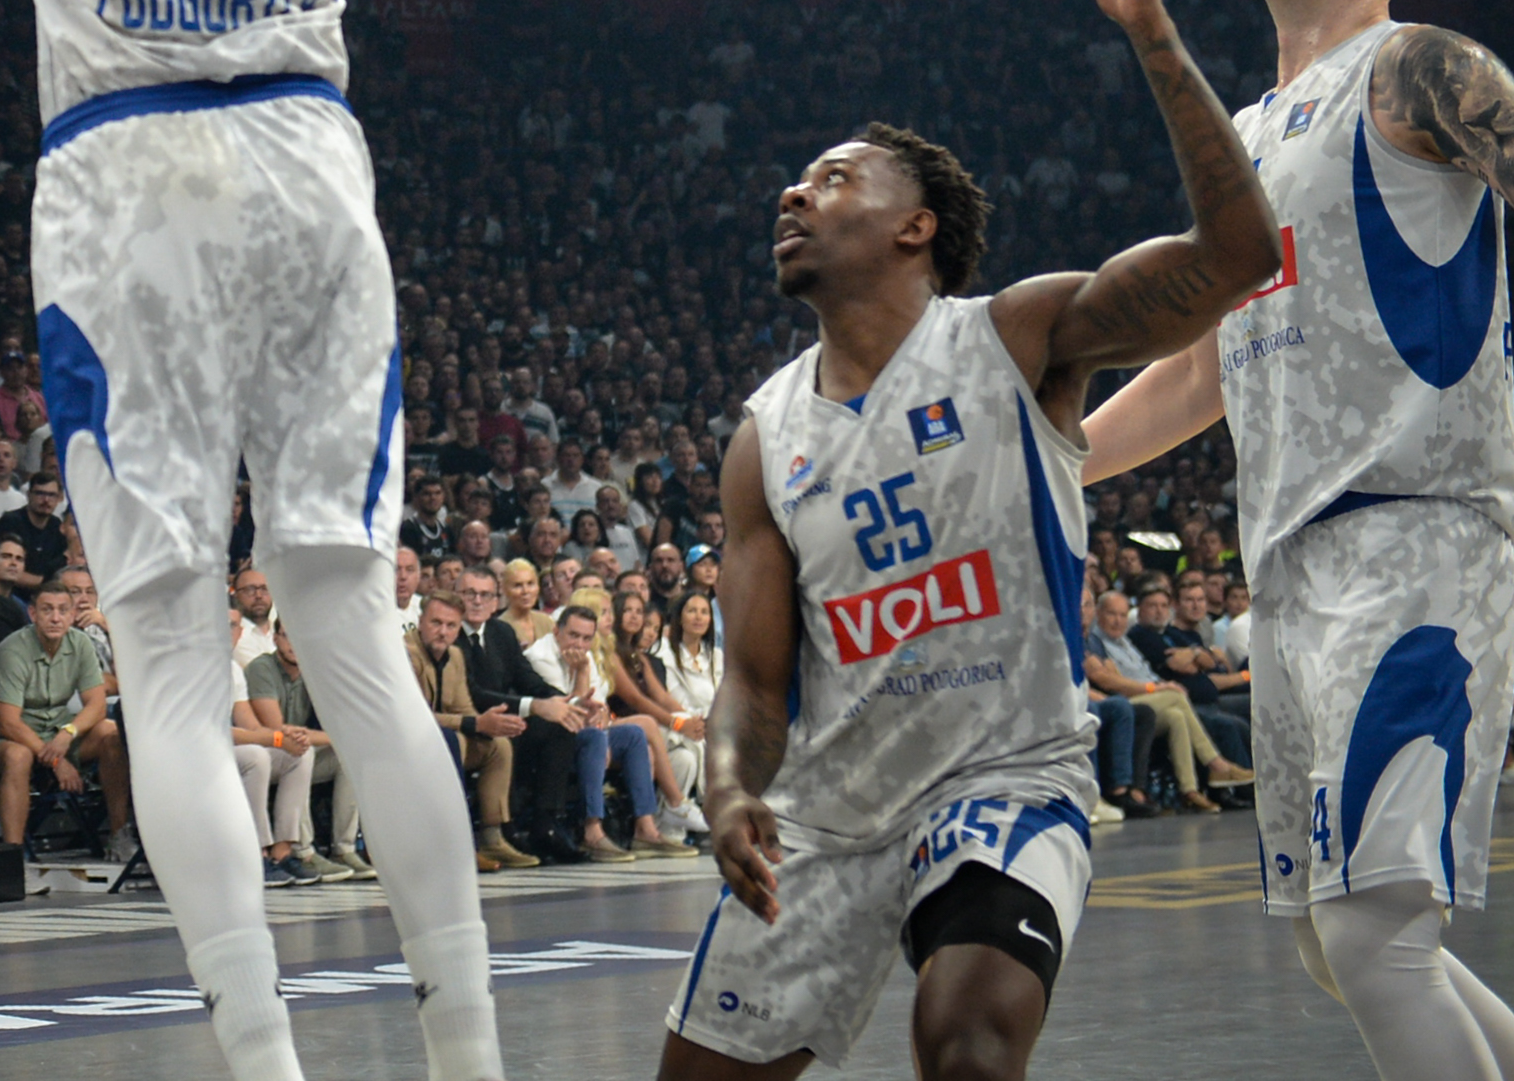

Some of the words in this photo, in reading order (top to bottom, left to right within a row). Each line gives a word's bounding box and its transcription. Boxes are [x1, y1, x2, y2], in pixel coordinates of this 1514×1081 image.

[842, 470, 934, 572] 25
[835, 561, 984, 656] VOLI
[929, 797, 1011, 864] 25
[1311, 786, 1332, 862] 4
[741, 1000, 772, 1022] NLB
